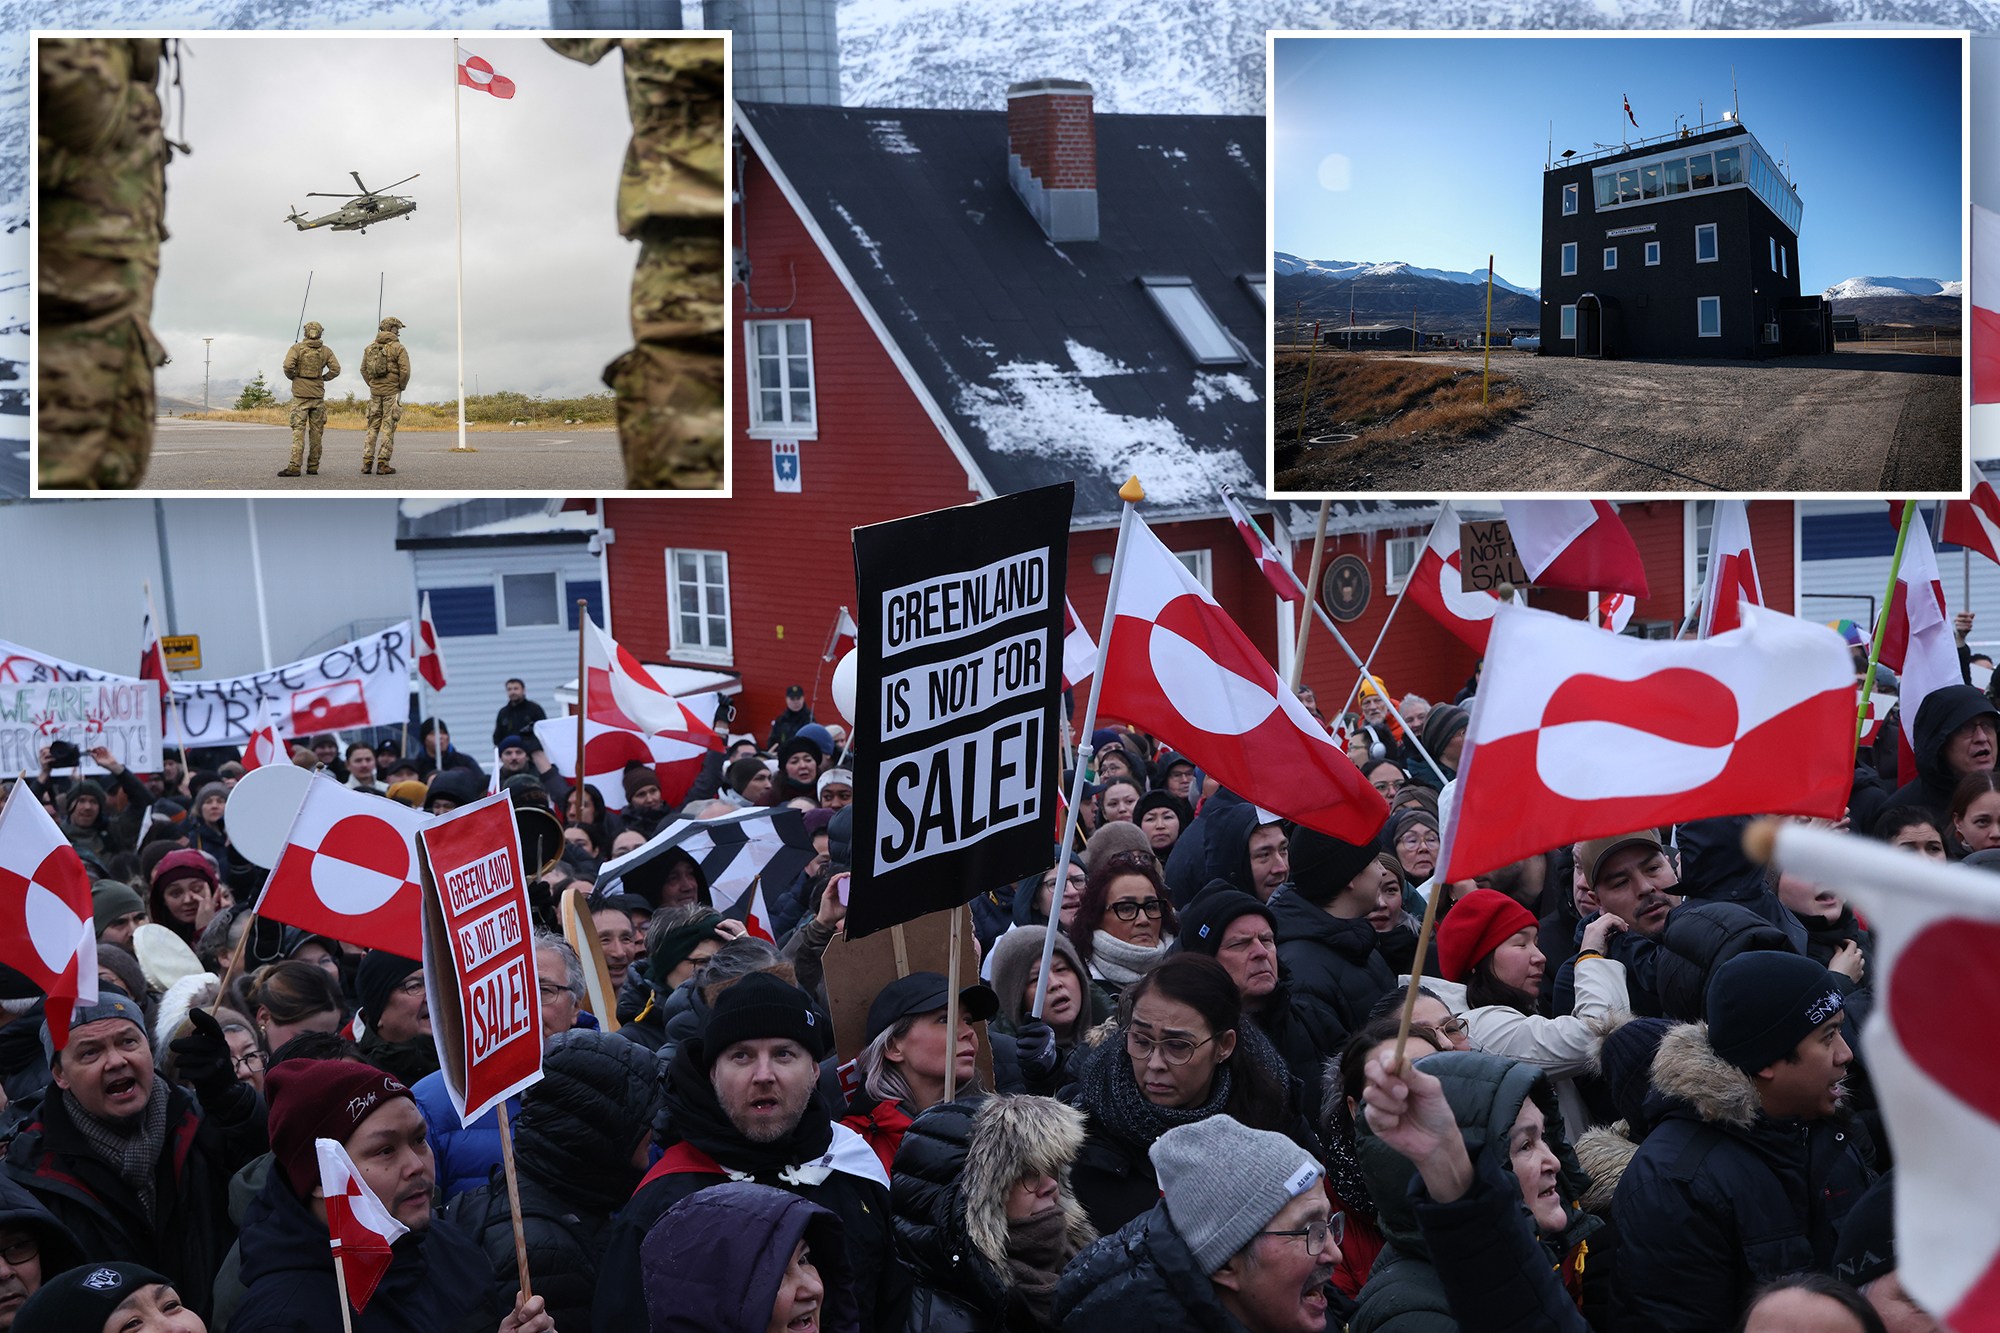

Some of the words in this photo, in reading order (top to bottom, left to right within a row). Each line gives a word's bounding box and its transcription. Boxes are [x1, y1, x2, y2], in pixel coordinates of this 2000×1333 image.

[1470, 522, 1506, 544] WE
[1470, 544, 1507, 564] NOT
[887, 556, 1044, 648] GREENLAND
[319, 631, 406, 679] OUR
[0, 688, 35, 723] WE
[46, 686, 93, 722] ARE
[98, 684, 149, 721] NOT
[886, 677, 911, 733] IS
[928, 656, 984, 721] NOT
[993, 638, 1042, 698] FOR
[881, 718, 1040, 864] SALE!
[448, 853, 511, 911] GREENLAND
[461, 930, 475, 967] IS
[474, 917, 496, 959] NOT
[498, 906, 520, 946] FOR
[473, 961, 528, 1058] SALE!
